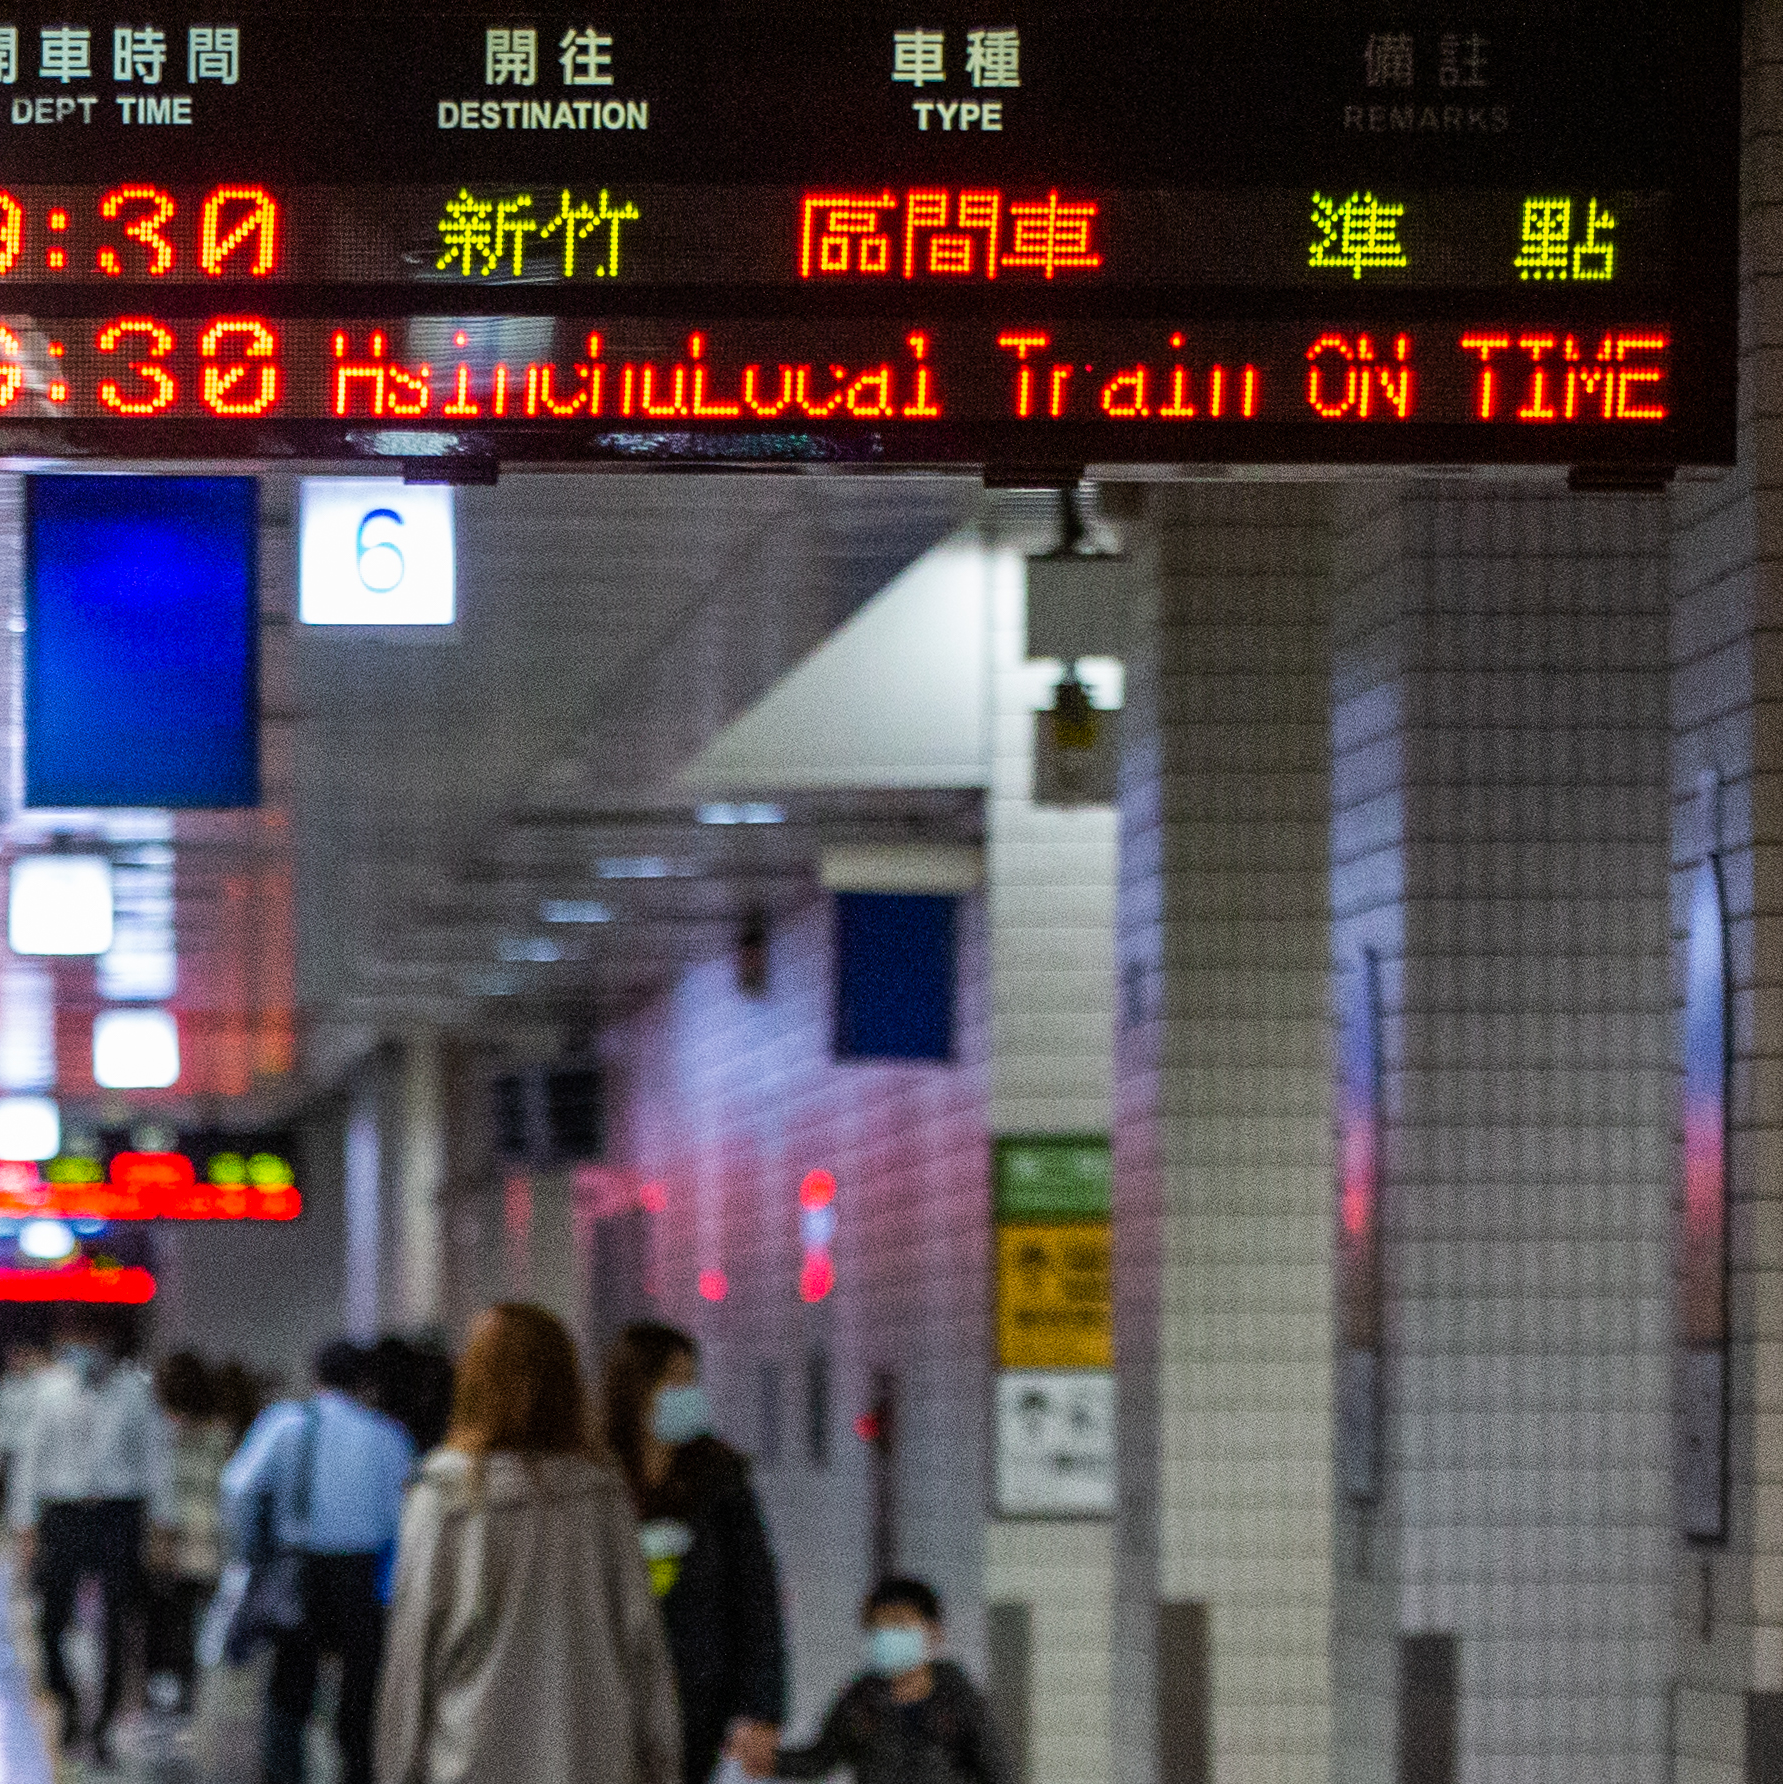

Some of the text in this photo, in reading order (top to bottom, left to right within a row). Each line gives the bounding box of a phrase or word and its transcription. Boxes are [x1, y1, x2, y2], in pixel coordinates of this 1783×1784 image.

[484, 28, 615, 87] 開往
[892, 26, 1021, 88] 車種
[1364, 33, 1491, 88] 備註
[11, 97, 193, 125] DEPT TIME
[438, 102, 648, 130] DESTINATION
[912, 102, 1003, 131] TYPE
[1343, 104, 1509, 133] REMARKS
[436, 188, 639, 277] 新竹
[798, 187, 1103, 280] 區間車
[997, 329, 1258, 417] Train
[1305, 331, 1670, 421] ON TIME
[354, 508, 406, 594] 6
